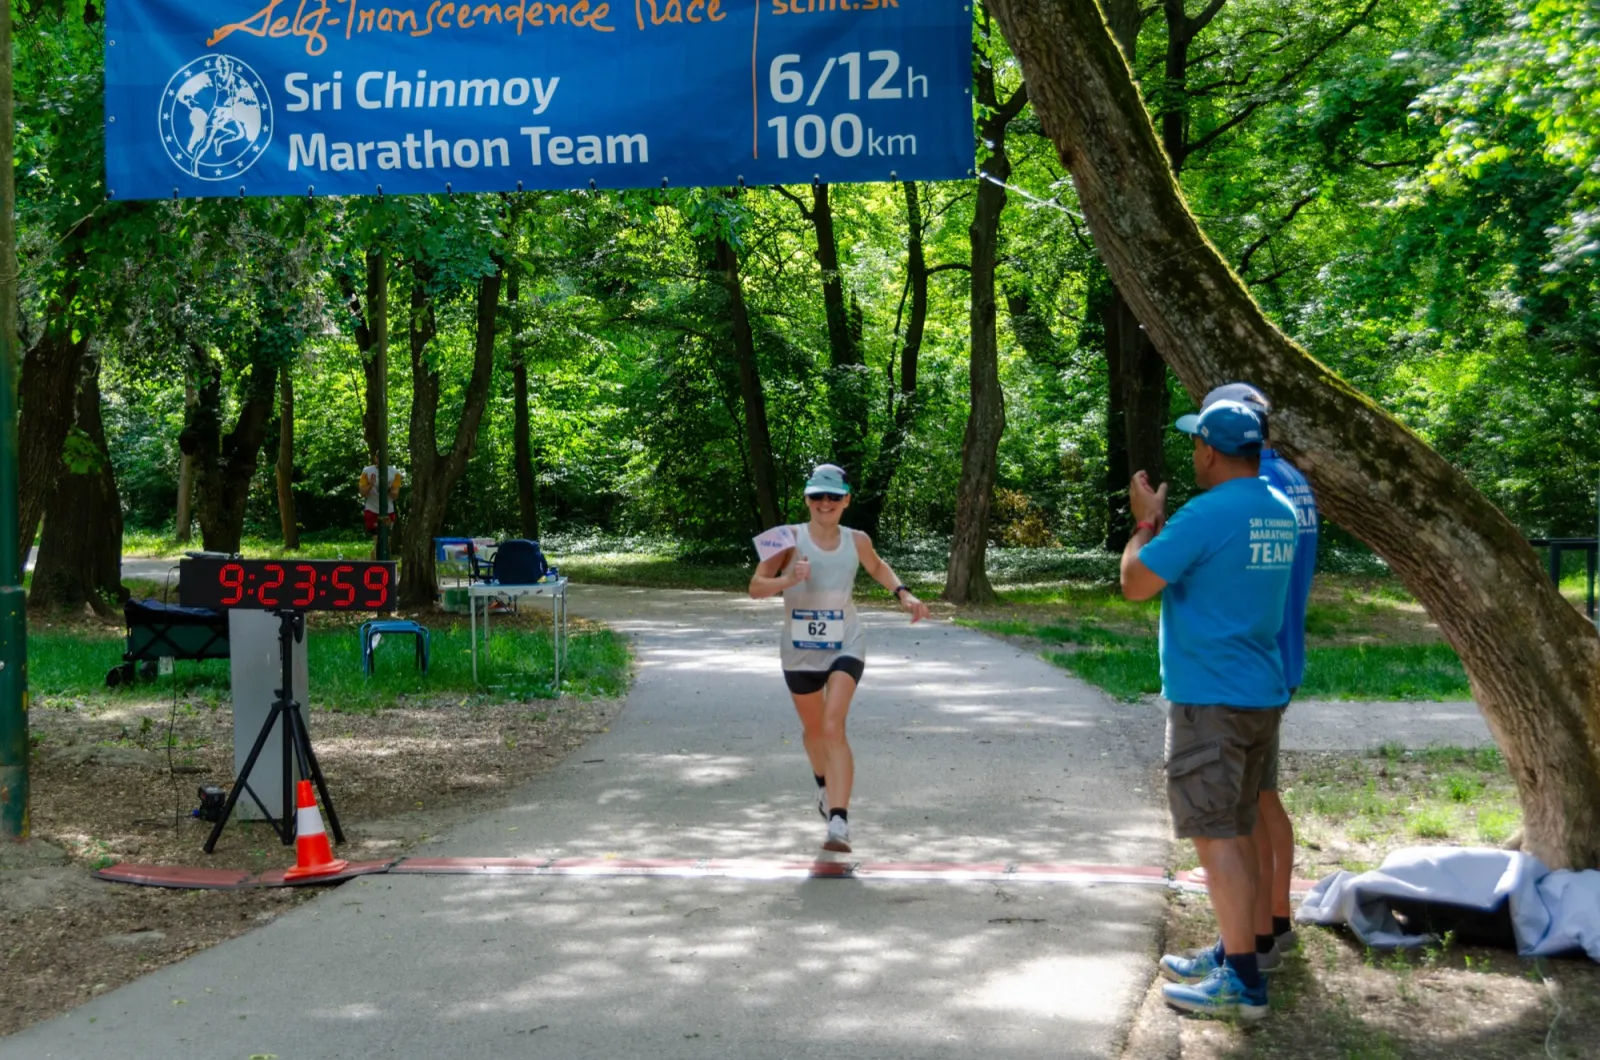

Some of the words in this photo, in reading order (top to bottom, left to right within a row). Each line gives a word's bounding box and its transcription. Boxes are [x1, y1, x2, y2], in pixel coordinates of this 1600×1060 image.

[284, 71, 343, 112] Sri
[355, 69, 560, 115] Chinmoy
[288, 129, 510, 172] Marathon
[520, 126, 649, 166] Team
[218, 563, 389, 607] 9:23:59
[807, 621, 827, 636] 62
